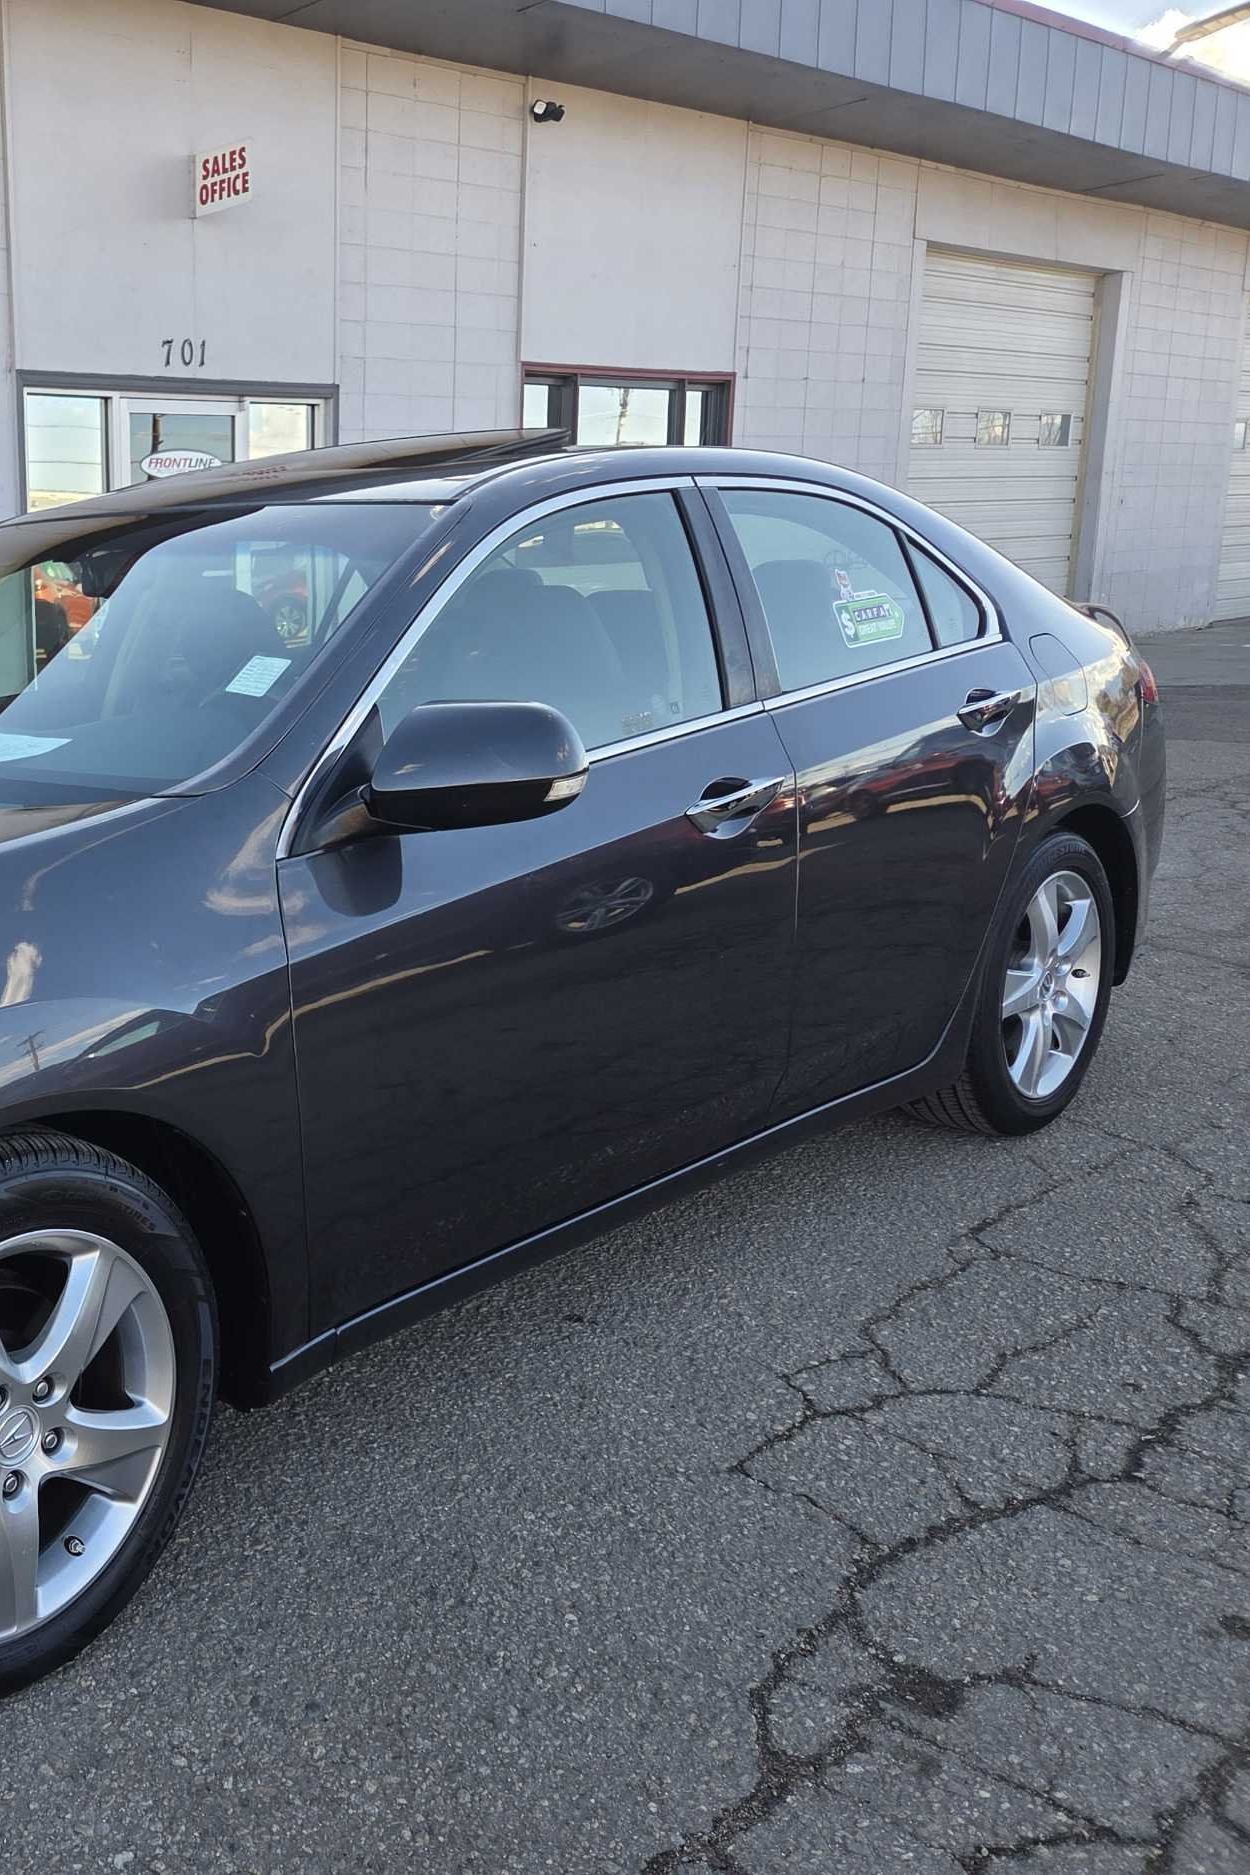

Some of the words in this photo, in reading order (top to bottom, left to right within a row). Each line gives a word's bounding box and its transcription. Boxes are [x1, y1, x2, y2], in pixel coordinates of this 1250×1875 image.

[201, 146, 246, 181] SALES
[199, 171, 250, 206] OFFICE
[161, 338, 206, 367] 701
[149, 457, 215, 469] FRONTLINE
